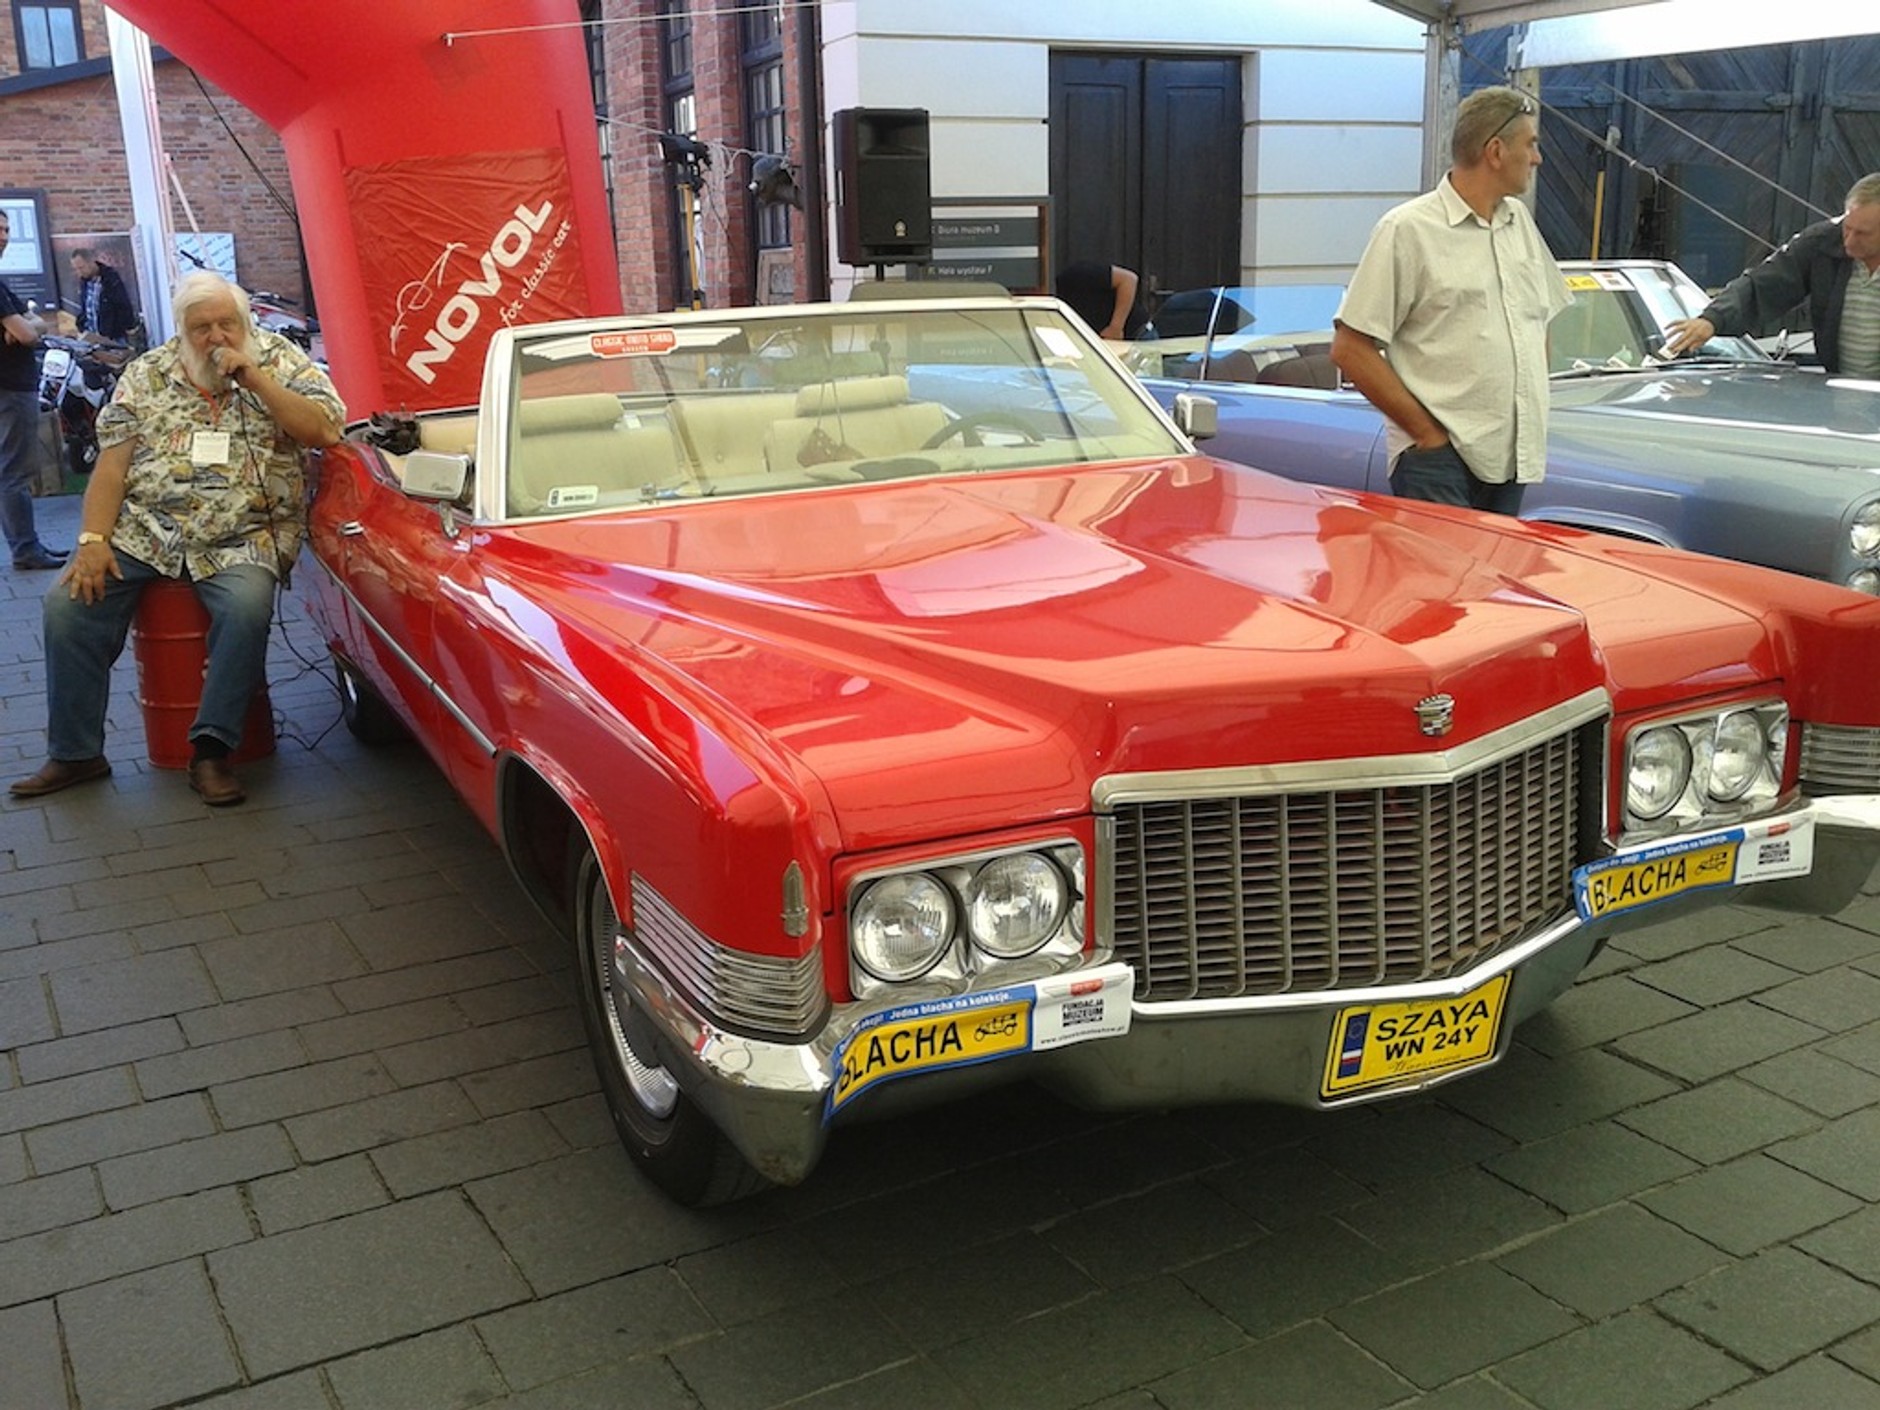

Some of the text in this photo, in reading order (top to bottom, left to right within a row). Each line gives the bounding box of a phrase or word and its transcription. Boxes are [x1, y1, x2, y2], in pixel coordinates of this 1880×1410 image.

[960, 225, 993, 234] muzeum
[500, 220, 571, 327] for classic car
[405, 200, 553, 385] NOVOL
[1593, 858, 1687, 912] BLACHA
[890, 1004, 919, 1020] Jedna
[921, 1001, 954, 1015] blacha
[955, 998, 968, 1008] na
[1062, 999, 1104, 1010] FUNDACJA
[1062, 1008, 1104, 1020] MUZEUM
[1375, 1000, 1490, 1042] SZAYA
[1385, 1025, 1481, 1061] WN 24Y
